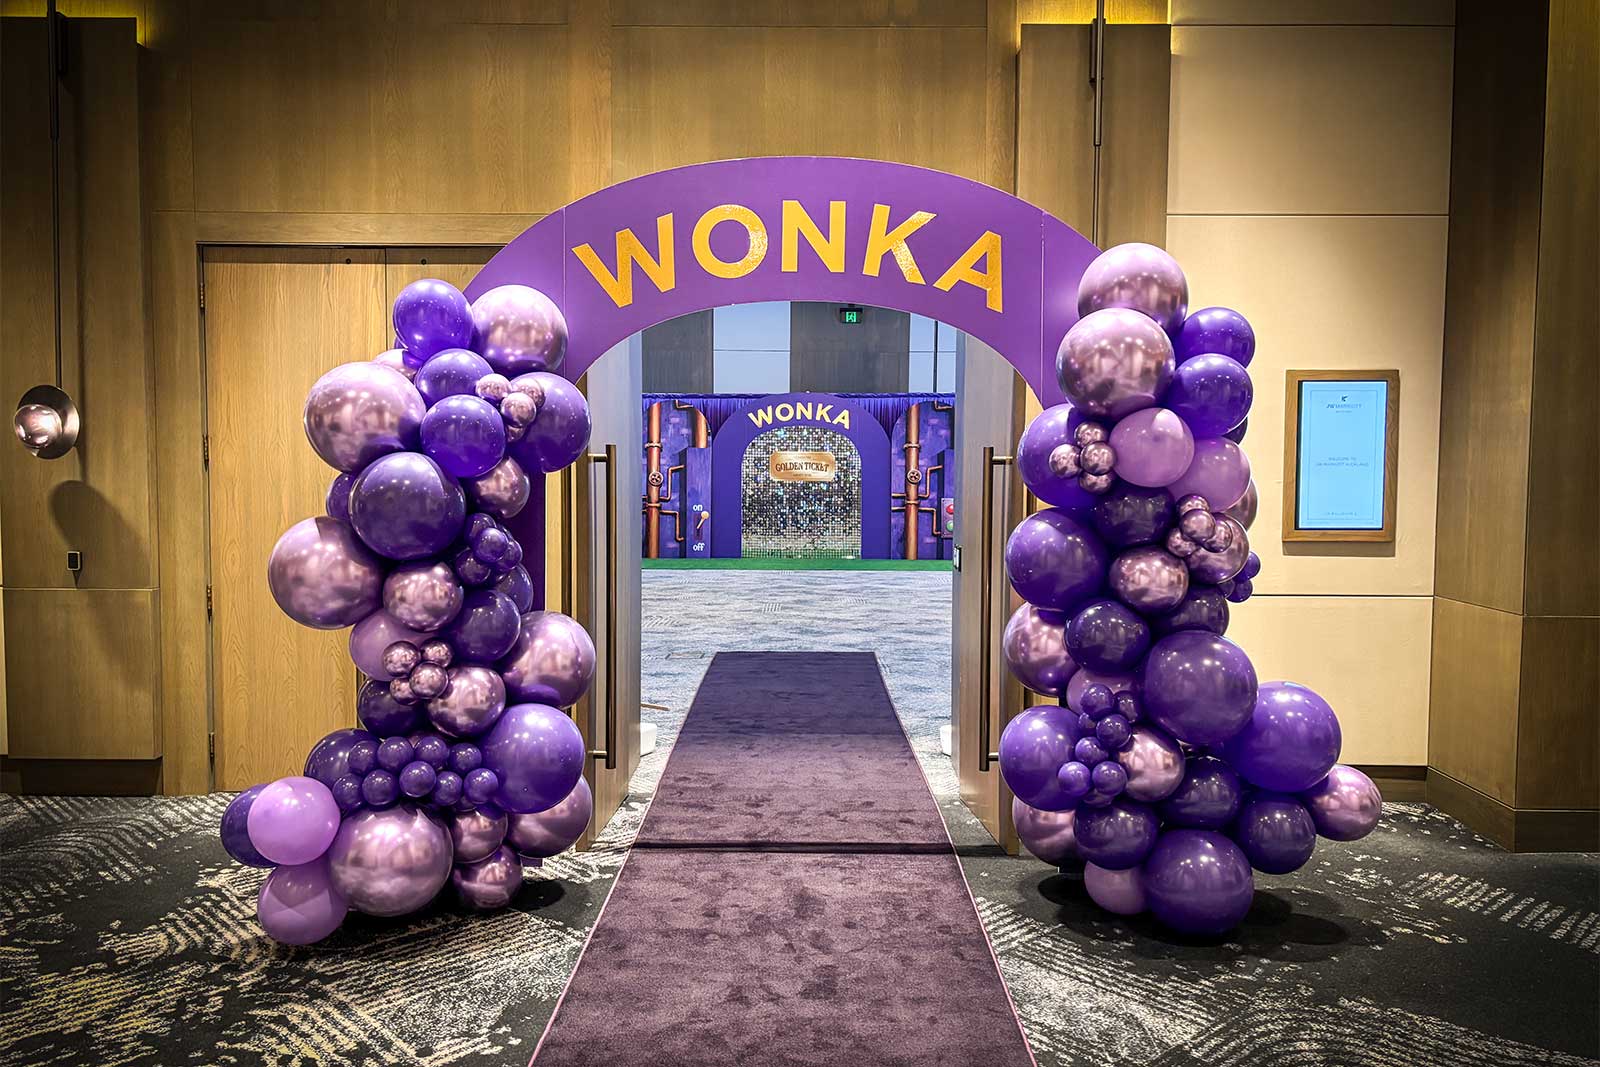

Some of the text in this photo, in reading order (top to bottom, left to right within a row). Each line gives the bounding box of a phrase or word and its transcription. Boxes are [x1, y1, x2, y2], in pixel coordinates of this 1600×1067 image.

[571, 199, 1004, 313] WONKA
[747, 402, 851, 430] WONKA
[775, 461, 830, 473] GOLDEN TICKET
[692, 504, 703, 512] on
[692, 542, 705, 552] off
